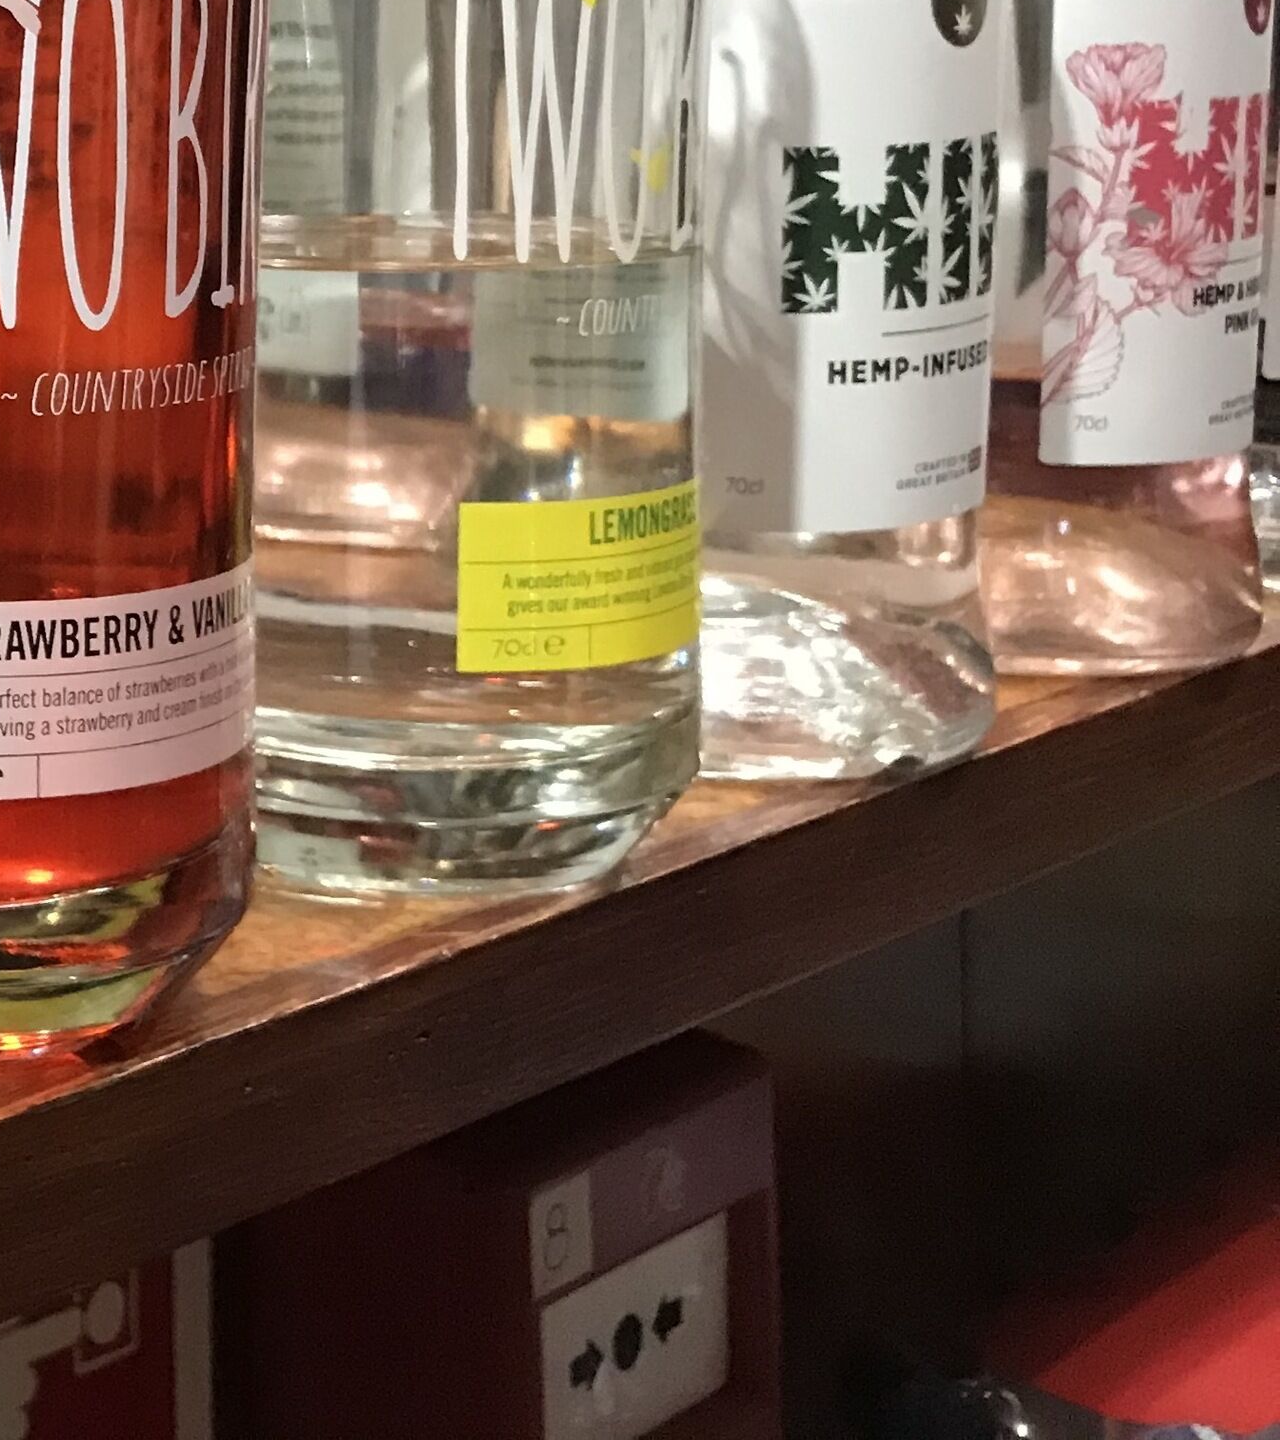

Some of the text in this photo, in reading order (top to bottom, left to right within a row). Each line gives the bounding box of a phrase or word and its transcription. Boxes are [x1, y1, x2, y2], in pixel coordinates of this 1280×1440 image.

[1192, 283, 1235, 307] HEMP
[30, 359, 208, 417] COUNTRYSIDE
[168, 604, 185, 645] &
[492, 638, 537, 658] 70cl
[42, 686, 104, 708] balance
[107, 681, 121, 703] of
[41, 720, 51, 735] a
[56, 711, 133, 735] strawberry
[137, 703, 161, 725] and
